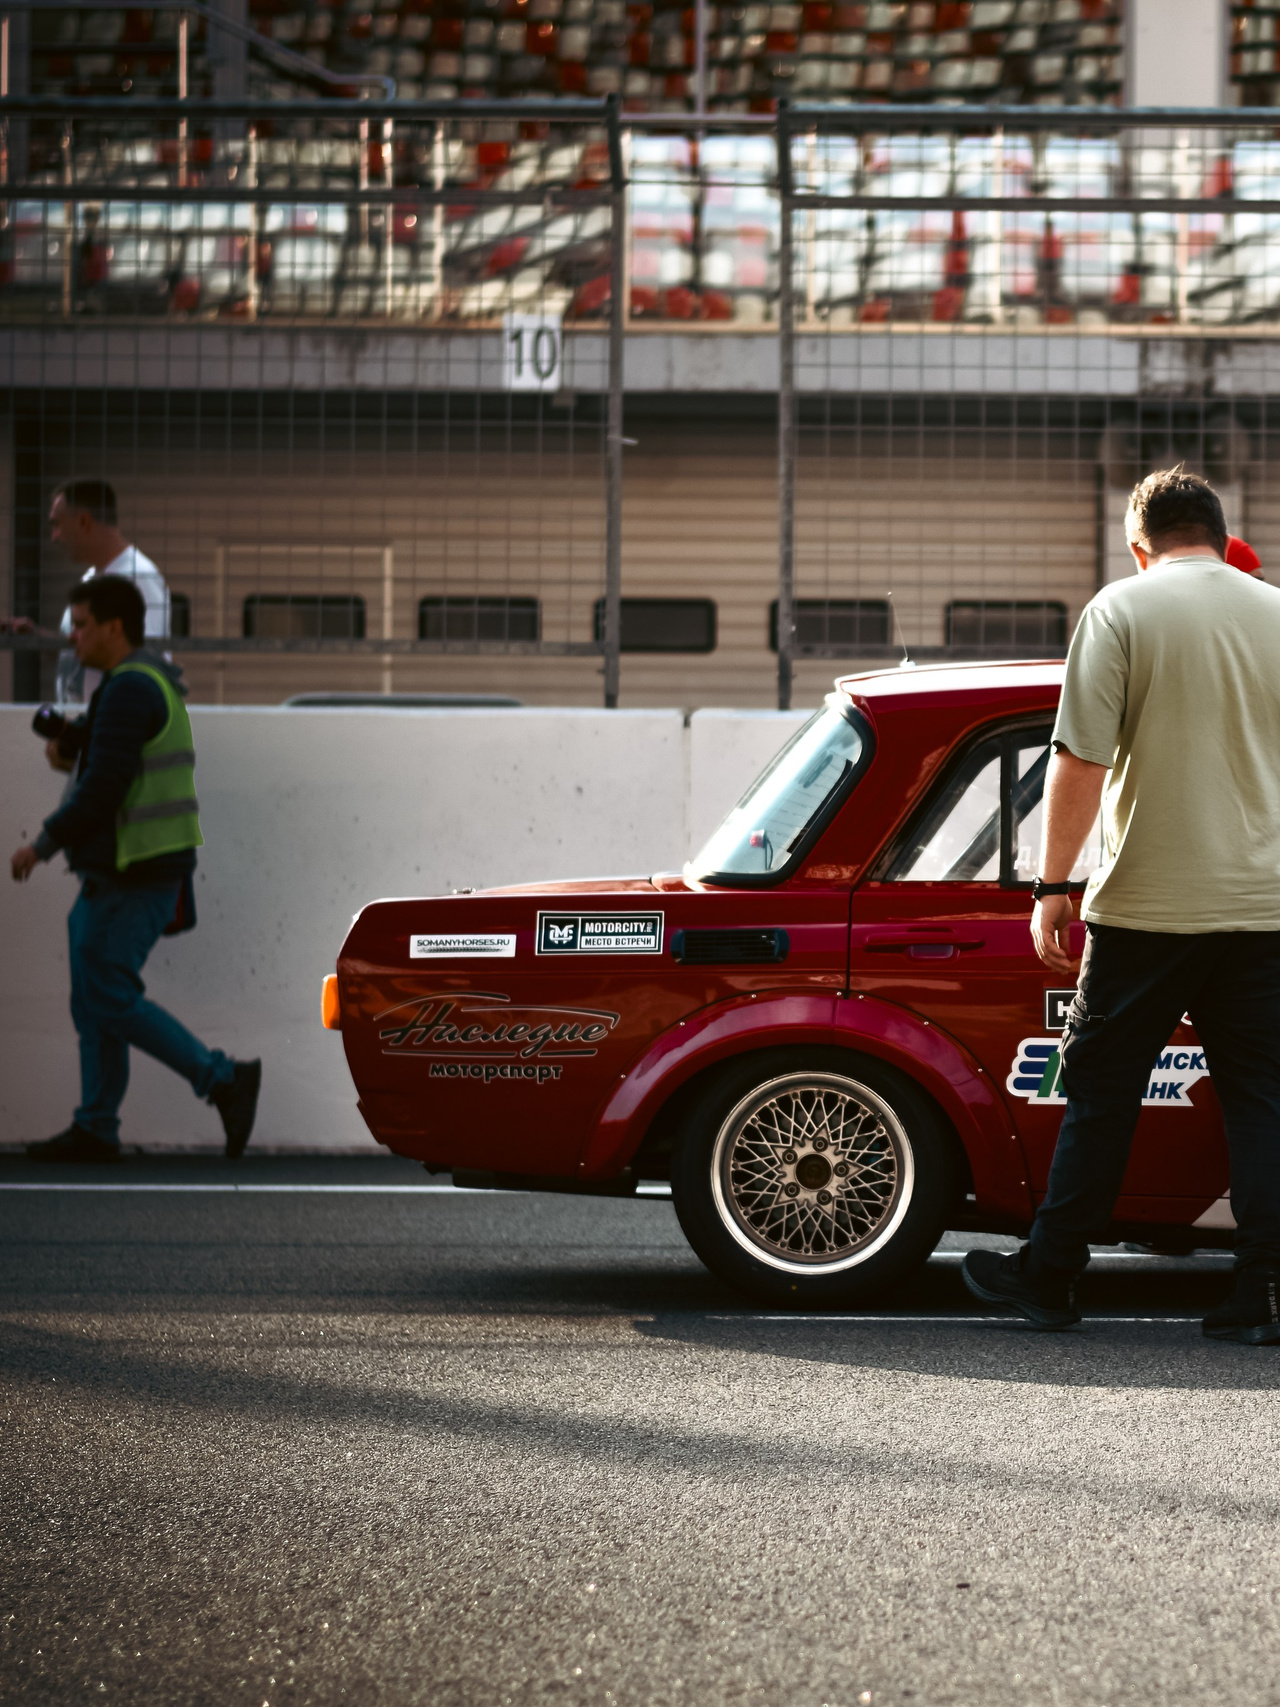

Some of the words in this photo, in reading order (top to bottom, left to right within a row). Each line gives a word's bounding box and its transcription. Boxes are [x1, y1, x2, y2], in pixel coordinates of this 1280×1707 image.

[509, 326, 557, 380] 10
[416, 938, 510, 947] SOMANYHORSES.RU
[585, 937, 611, 946] МЕСТО
[615, 937, 652, 945] ВСТРЕЧИ
[379, 1002, 608, 1058] Наследие
[428, 1063, 562, 1084] моторспорт
